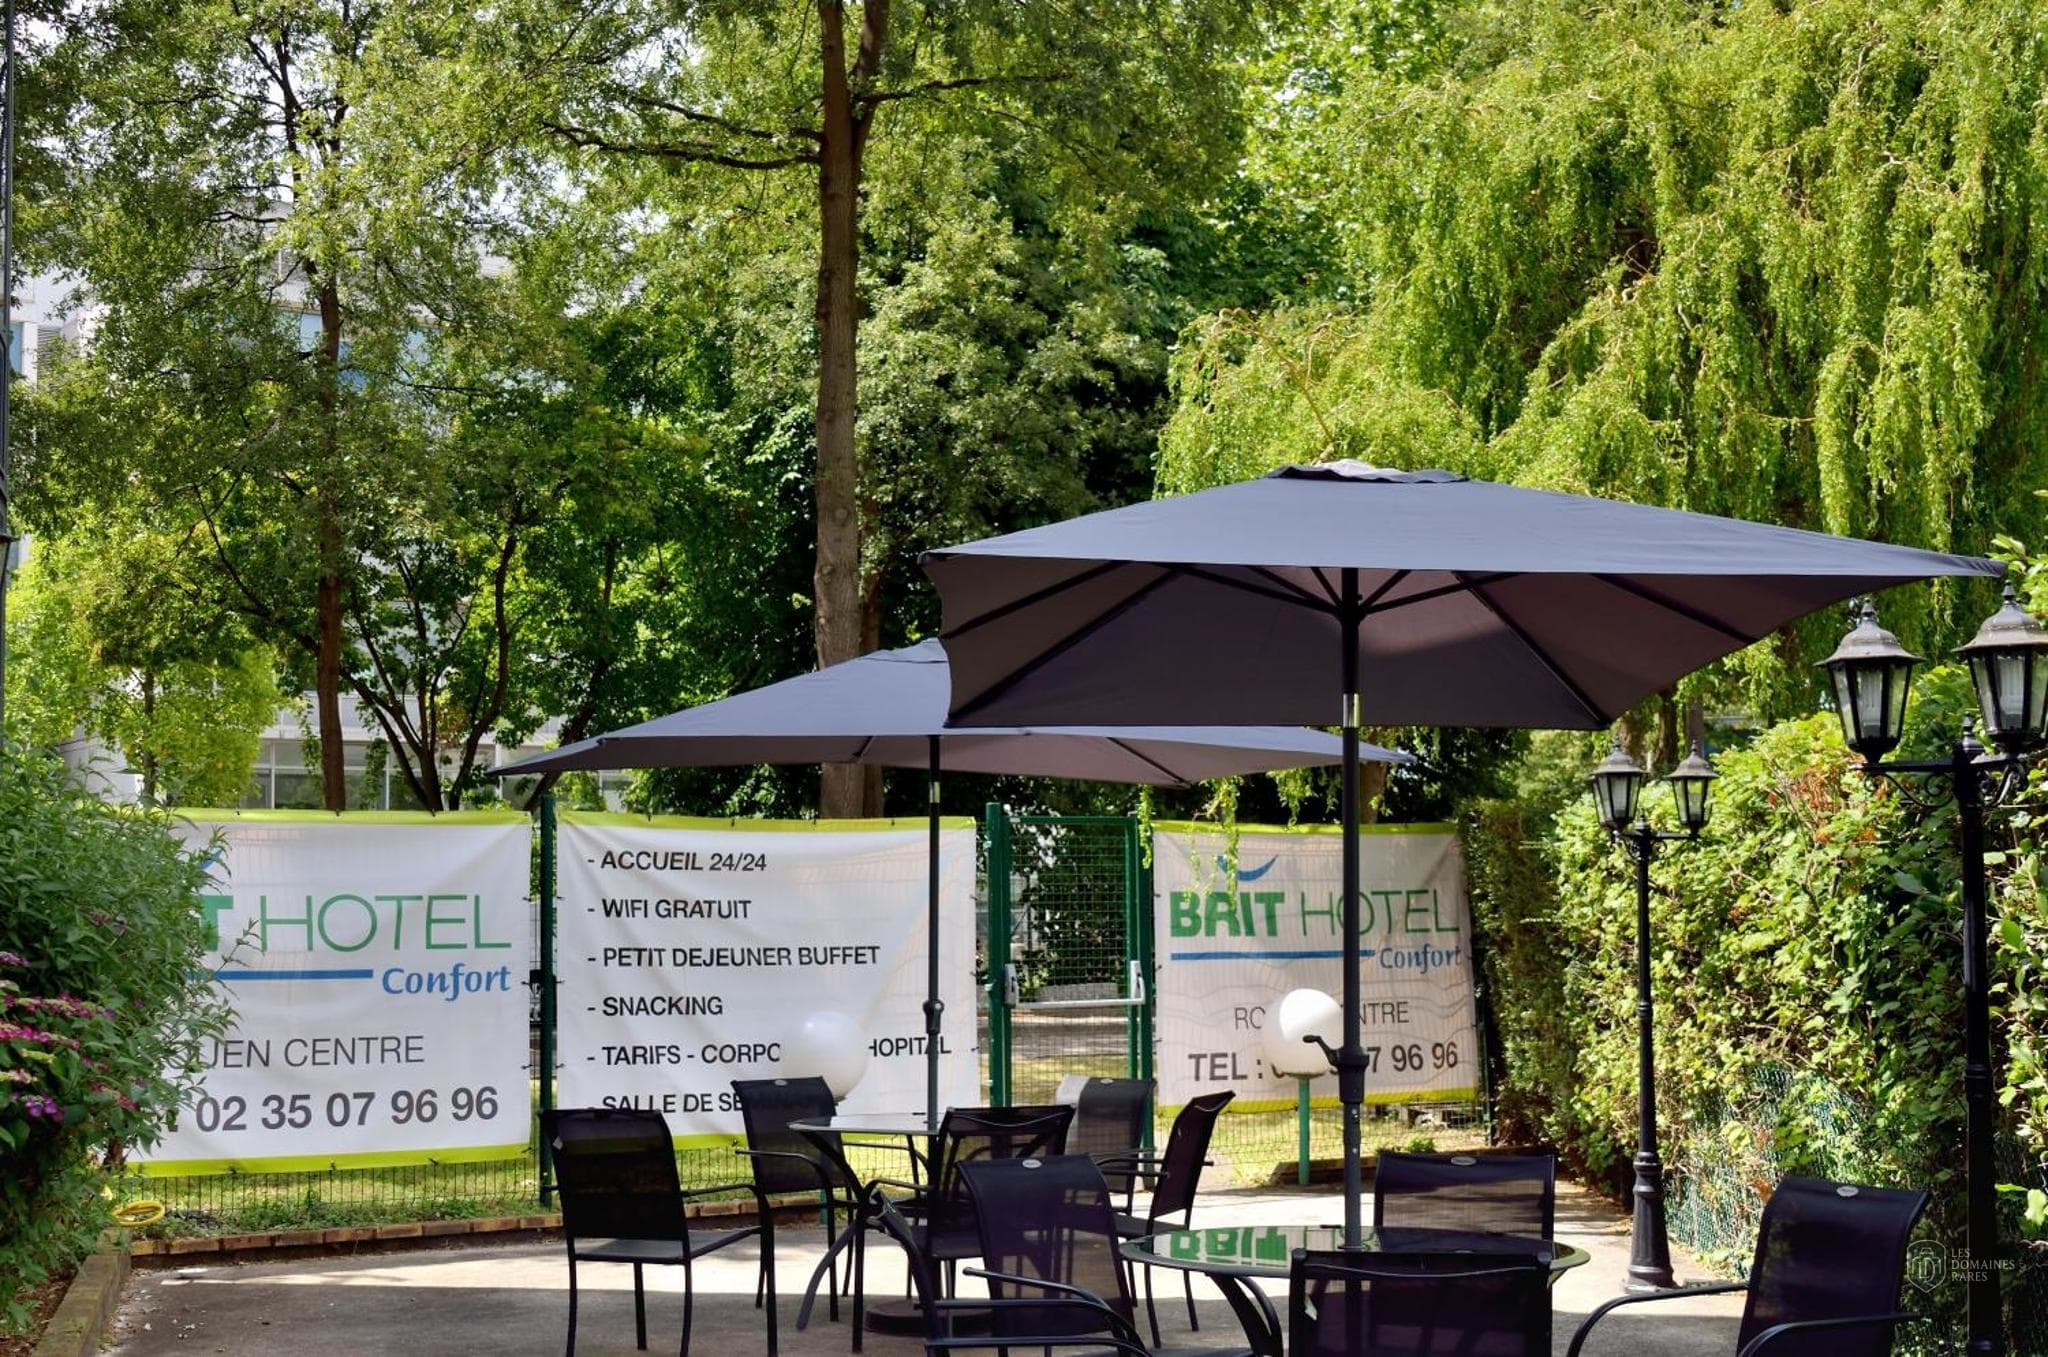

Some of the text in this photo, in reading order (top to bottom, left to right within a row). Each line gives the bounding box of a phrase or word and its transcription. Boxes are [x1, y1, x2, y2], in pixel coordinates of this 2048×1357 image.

[600, 850, 703, 871] ACCUEIL
[709, 852, 767, 872] 24/24
[260, 894, 512, 952] HOTEL
[601, 898, 648, 919] WIFI
[654, 899, 752, 919] GRATUIT
[1170, 888, 1460, 938] BRIT HOTEL
[603, 947, 666, 967] PETIT
[672, 947, 791, 967] DEJEUNER
[798, 945, 881, 966] BUFFET
[1379, 944, 1462, 975] Confort
[382, 963, 511, 1001] Confort
[602, 996, 723, 1016] SNACKING
[284, 1035, 425, 1068] CENTRE
[602, 1044, 681, 1066] TARIFS
[868, 1036, 952, 1057] HOPITL
[1188, 1052, 1249, 1082] TEL
[1391, 1043, 1424, 1072] 96
[1432, 1041, 1459, 1070] 96
[195, 1086, 499, 1133] 02 35 07 96 96
[683, 1093, 713, 1112] DE
